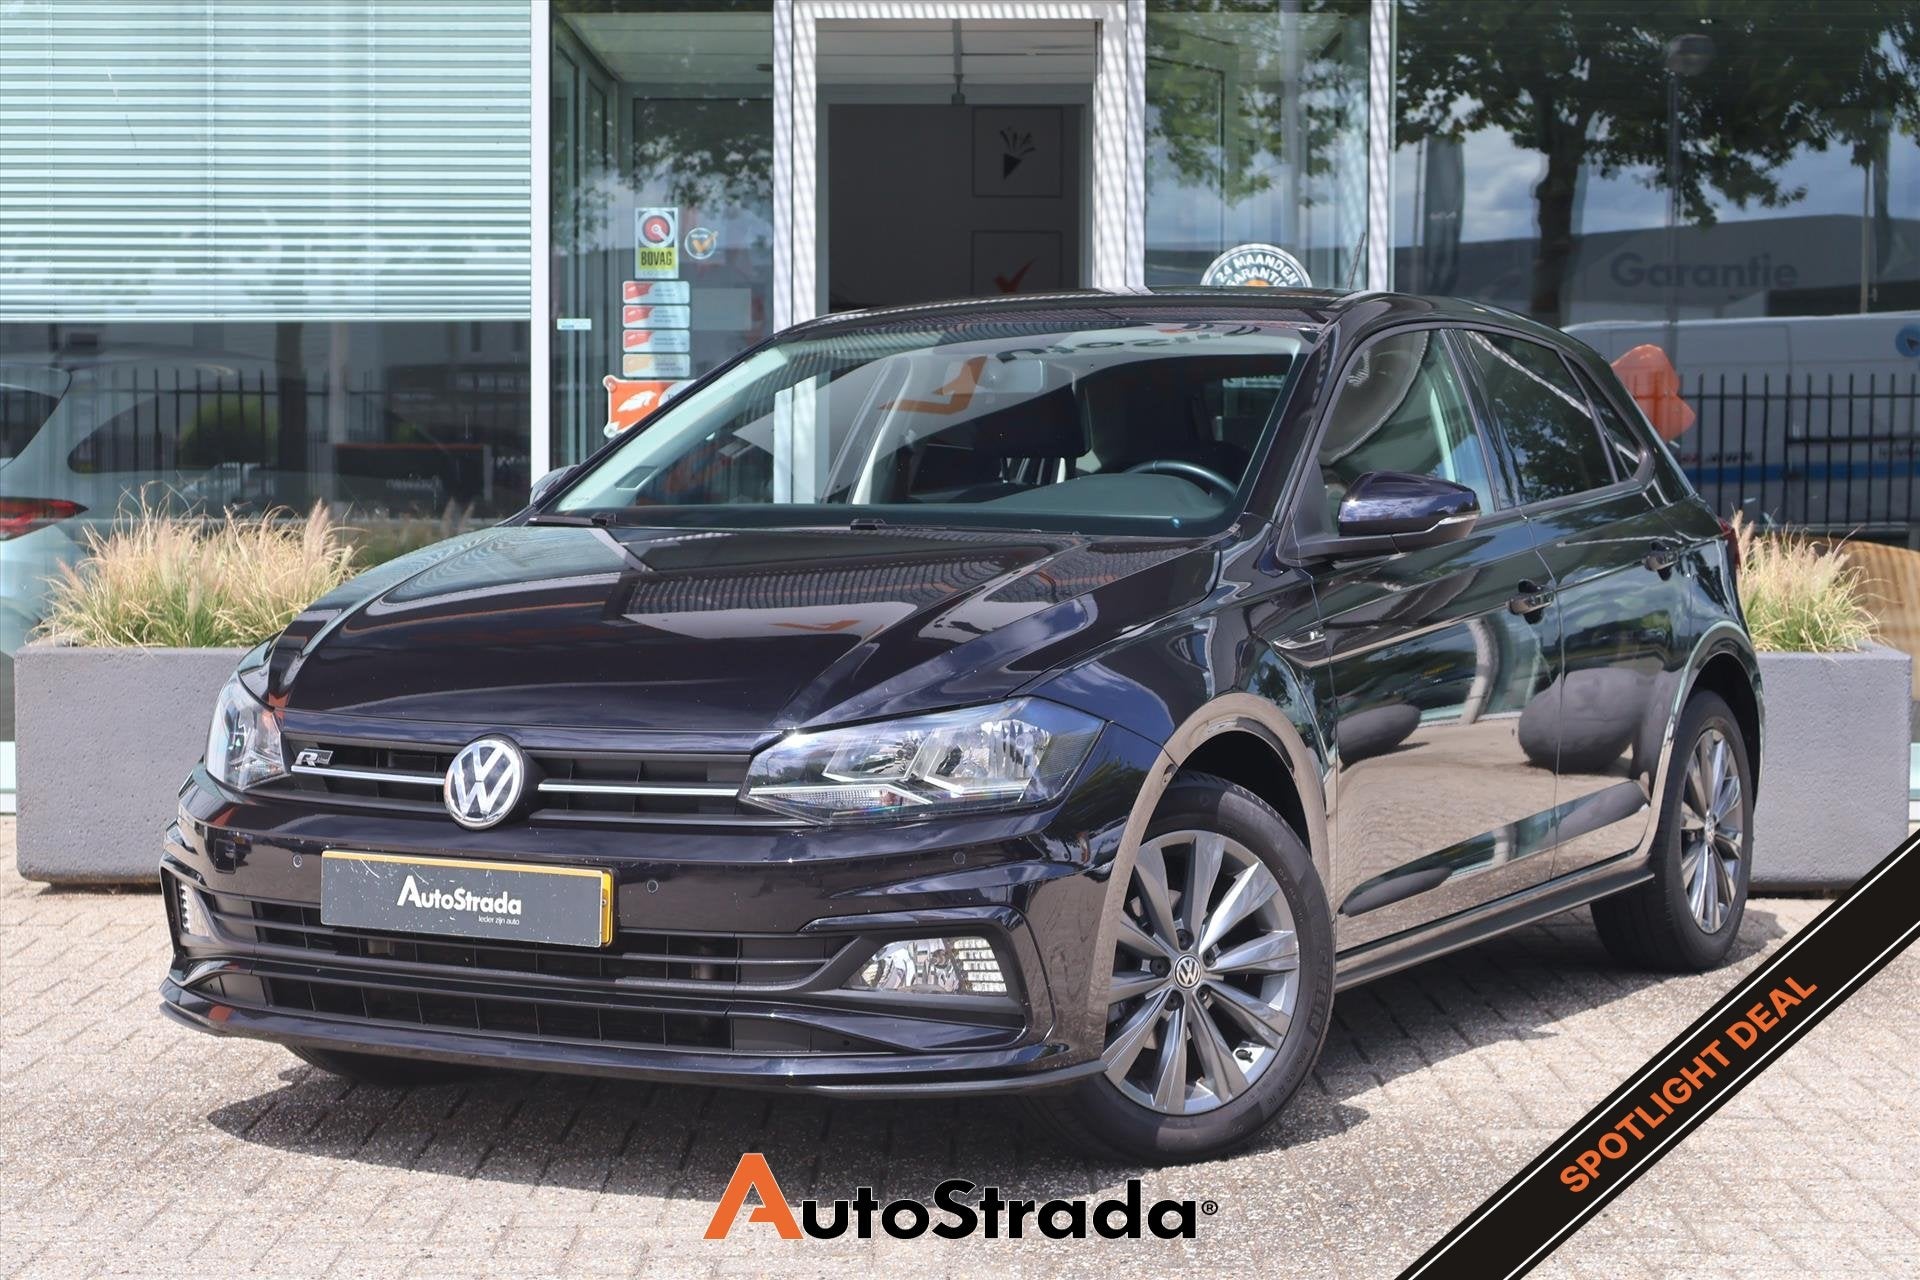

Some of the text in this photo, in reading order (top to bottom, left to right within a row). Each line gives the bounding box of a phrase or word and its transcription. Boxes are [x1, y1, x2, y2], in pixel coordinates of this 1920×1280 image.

[641, 250, 673, 266] BOVAG
[1215, 253, 1300, 285] 24 MAANDEN
[1610, 252, 1799, 288] Garantie
[396, 874, 522, 915] AutoStrada
[506, 918, 520, 926] auto
